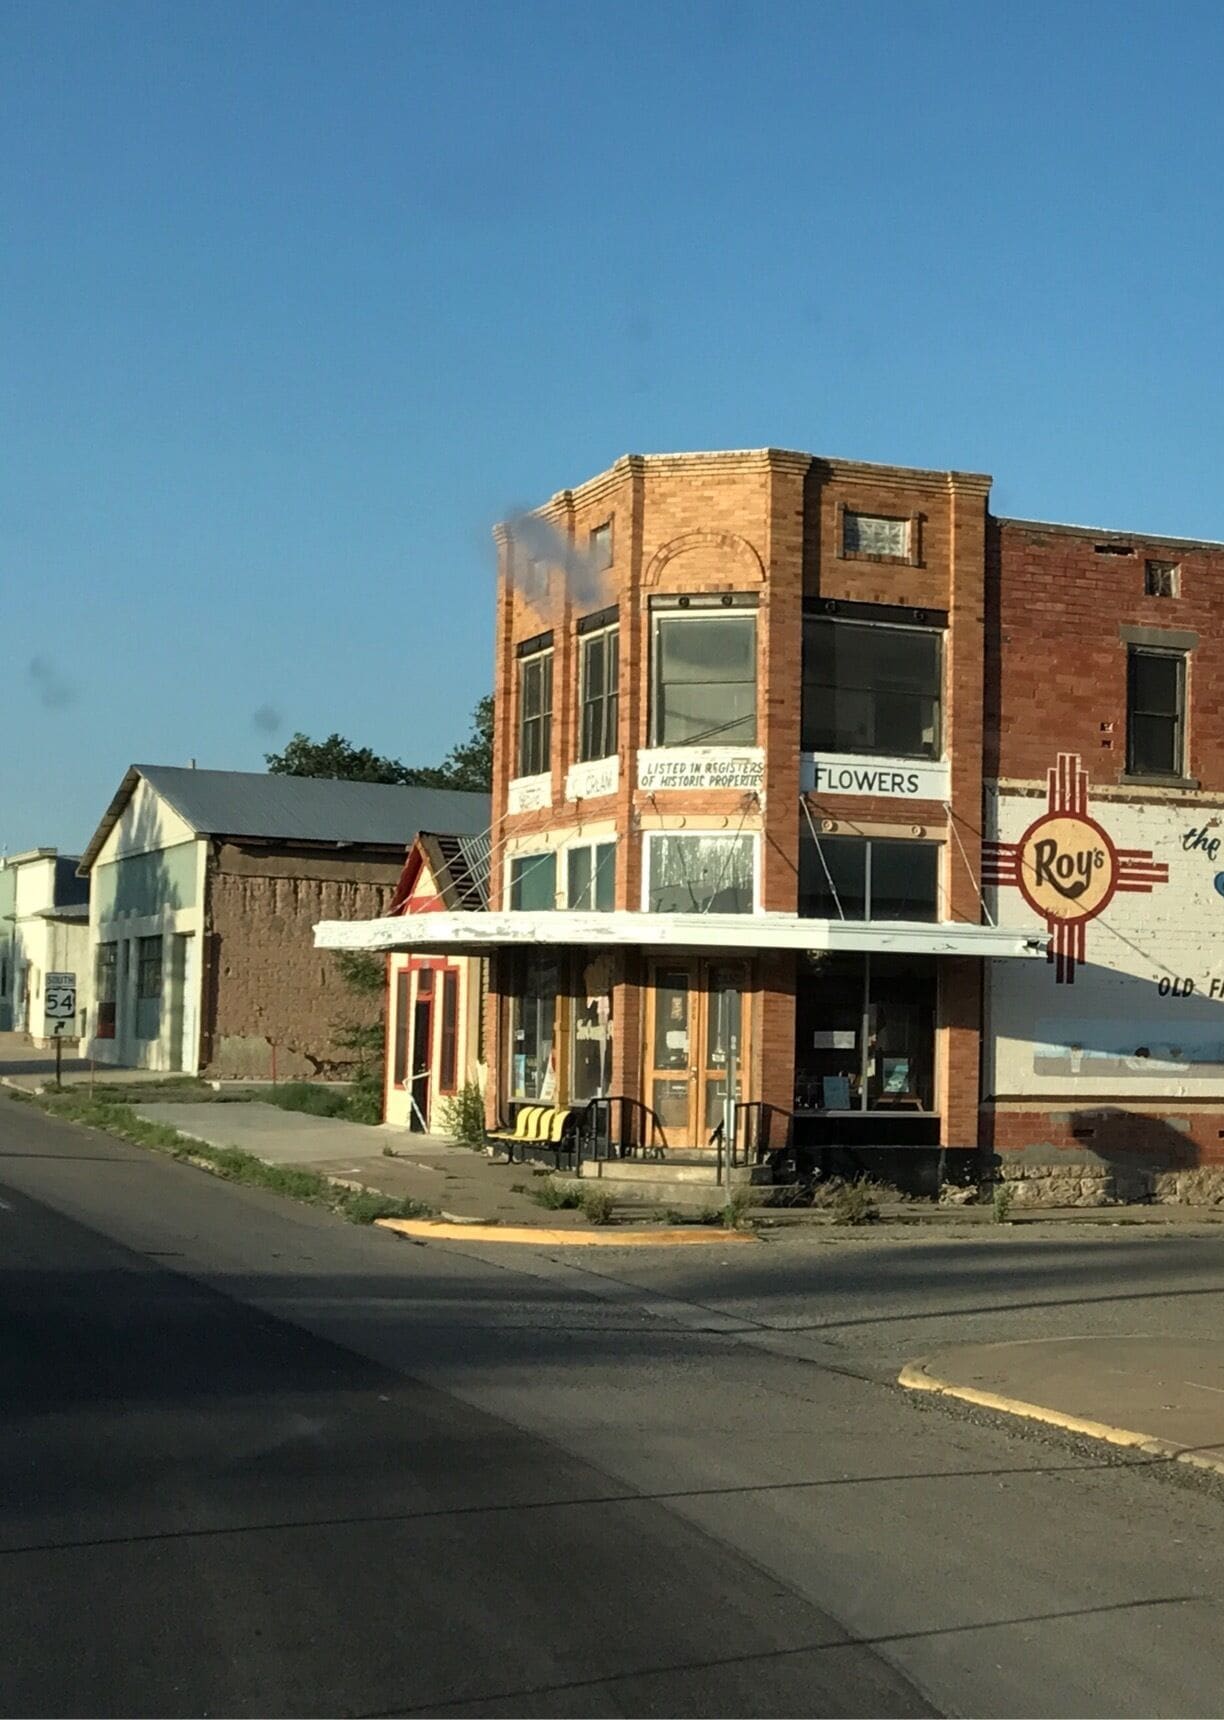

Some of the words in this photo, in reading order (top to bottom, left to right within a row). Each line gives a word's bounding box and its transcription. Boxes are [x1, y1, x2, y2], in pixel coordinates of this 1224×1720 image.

[647, 762, 686, 775] LISTED
[690, 762, 702, 774] IN
[705, 762, 763, 774] REGISTERS
[641, 775, 656, 787] OF
[660, 775, 705, 787] HISTORIC
[814, 767, 920, 794] FLOWERS
[1181, 827, 1221, 861] the
[1034, 838, 1105, 899] Roy's
[47, 976, 73, 985] SOUTH
[47, 994, 72, 1011] 54
